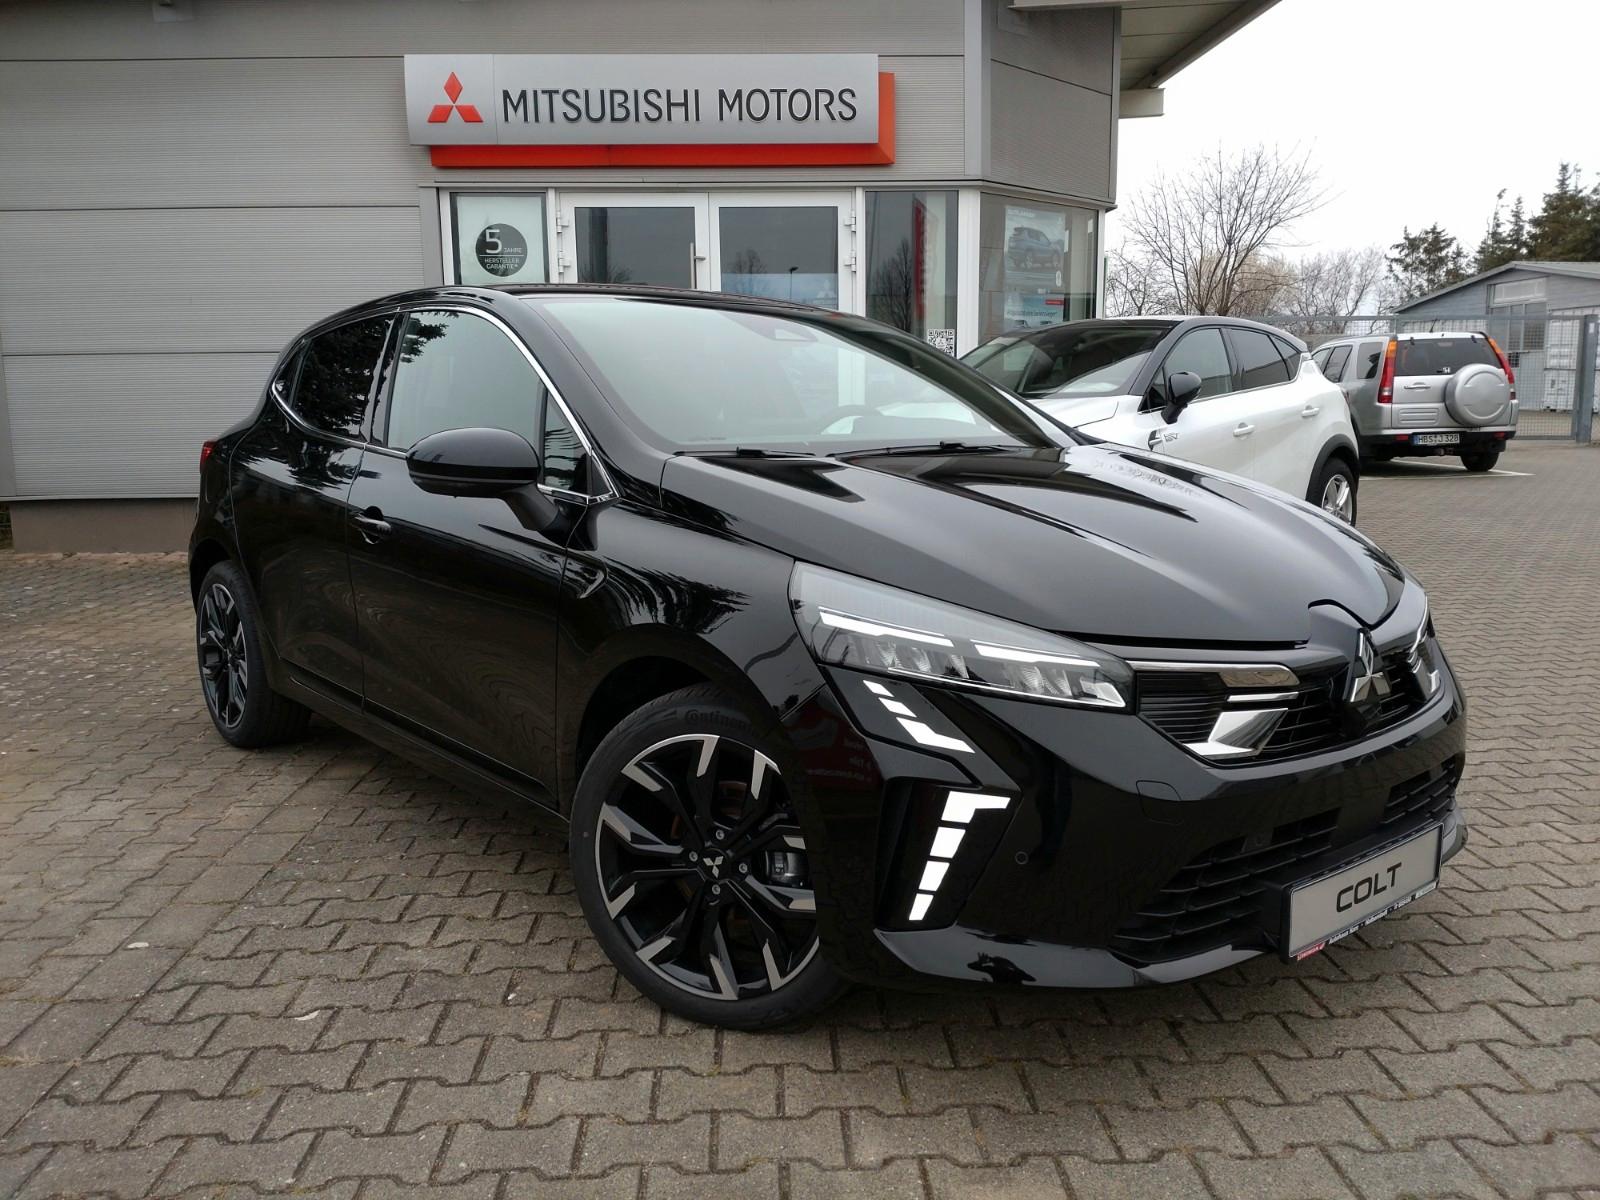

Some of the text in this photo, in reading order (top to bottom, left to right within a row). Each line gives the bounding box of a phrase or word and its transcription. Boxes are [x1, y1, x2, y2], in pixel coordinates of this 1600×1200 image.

[502, 88, 857, 123] MITSUBISHI MOTORS
[485, 229, 502, 254] 5
[1418, 435, 1434, 443] HBS
[1444, 434, 1459, 442] 328
[1336, 862, 1402, 913] COLT
